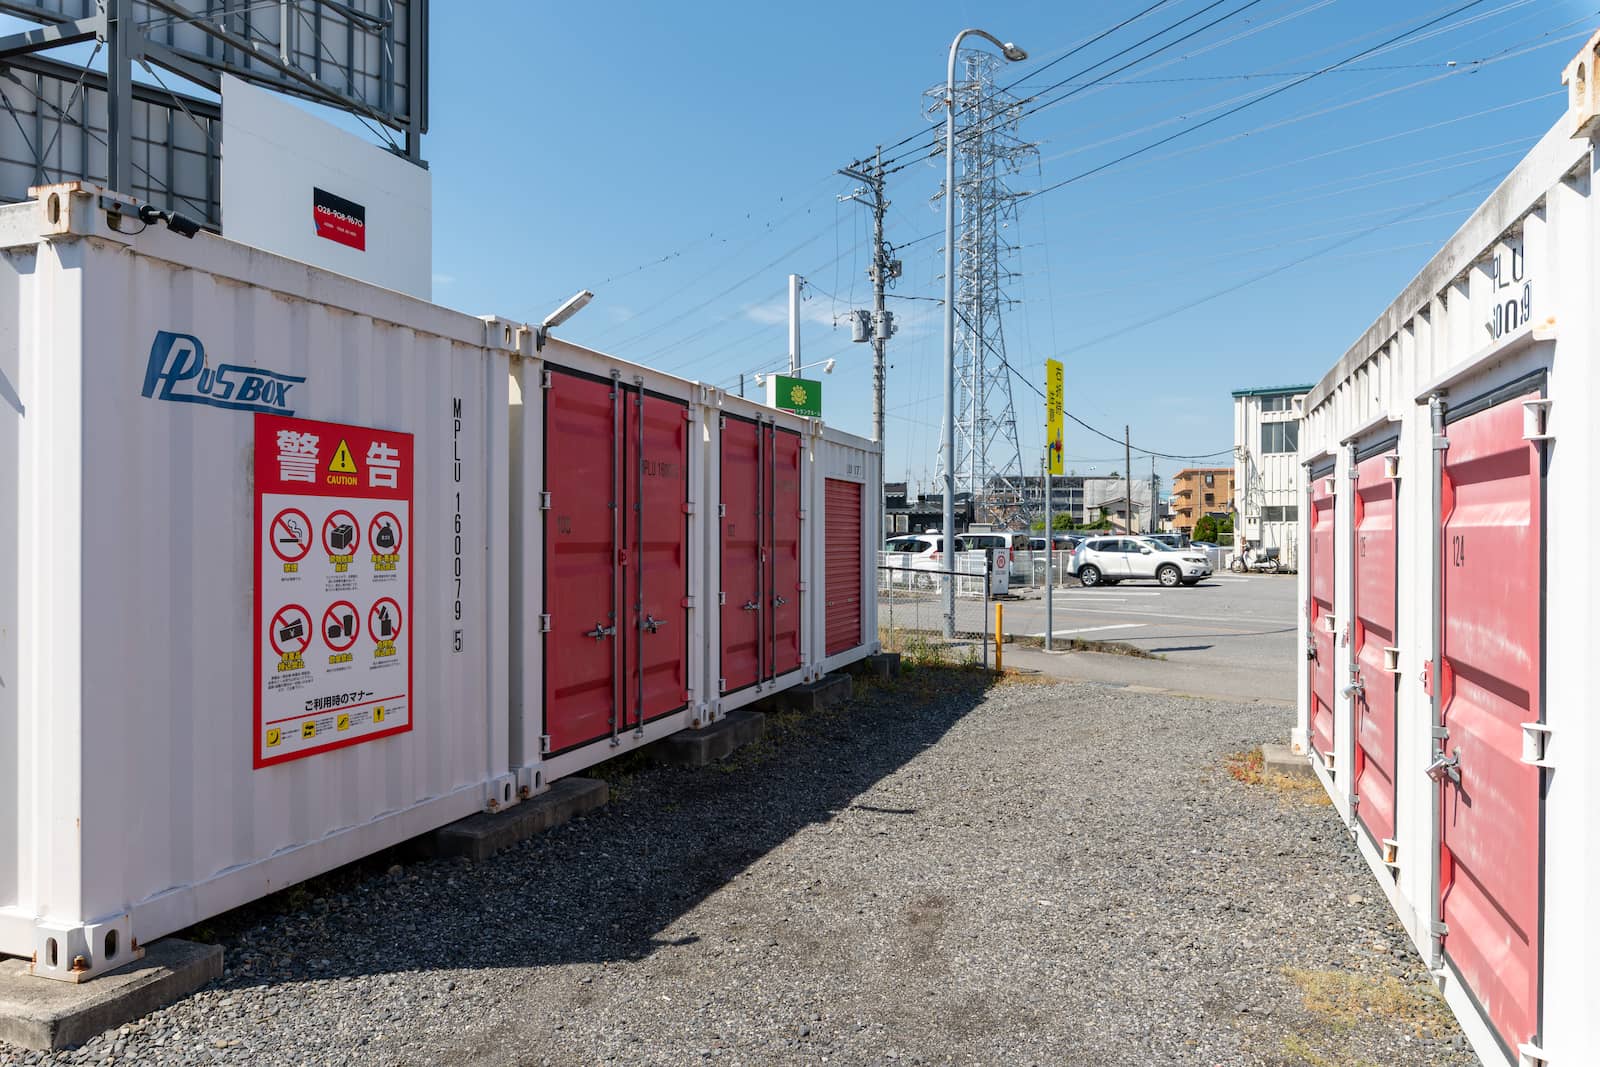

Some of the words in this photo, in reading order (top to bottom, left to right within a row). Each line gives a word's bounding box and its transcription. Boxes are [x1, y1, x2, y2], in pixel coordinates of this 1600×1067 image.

[453, 398, 462, 482] MPLU
[326, 475, 358, 487] CAUTION
[1453, 535, 1465, 567] 124
[305, 690, 374, 711] ご利用時のマナー
